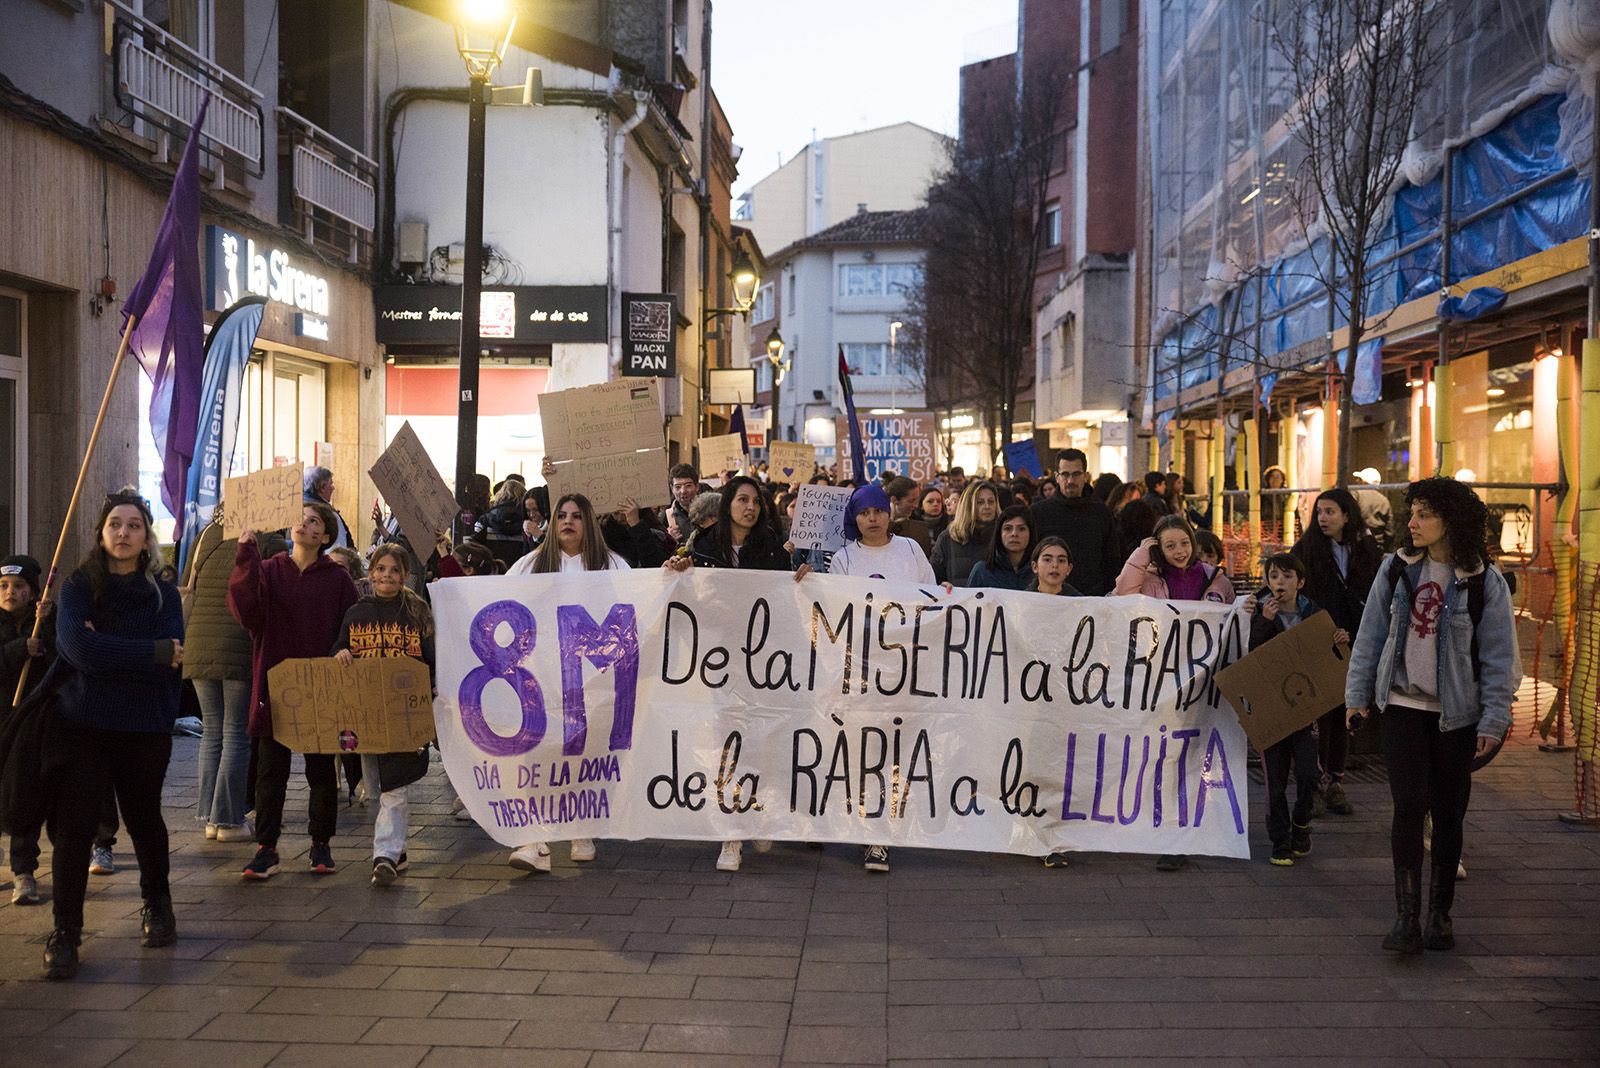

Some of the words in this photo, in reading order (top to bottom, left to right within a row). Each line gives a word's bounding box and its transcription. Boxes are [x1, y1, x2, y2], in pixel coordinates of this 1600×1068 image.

[247, 238, 268, 297] la
[269, 249, 329, 316] Sirena
[634, 344, 665, 353] MACXI
[631, 355, 667, 370] PAN
[203, 388, 225, 470] Sirena
[861, 419, 878, 437] TU
[883, 418, 928, 437] HOME,
[575, 440, 592, 450] NO
[862, 439, 931, 457] PARTICIPES
[199, 474, 217, 497] la
[803, 488, 851, 503] IGUALTA
[803, 500, 832, 511] ENTRE
[801, 512, 839, 524] DONES
[791, 530, 831, 542] HOMES
[349, 631, 421, 656] STRANGER
[458, 599, 640, 757] 8M
[662, 601, 730, 689] De
[740, 597, 801, 692] la
[1020, 659, 1054, 703] a
[1063, 615, 1116, 709] la
[517, 763, 541, 789] DE
[548, 760, 571, 787] LA
[577, 754, 621, 784] DONA
[950, 775, 985, 817] a
[999, 737, 1047, 818] la
[487, 787, 610, 829] TREBALLADORA
